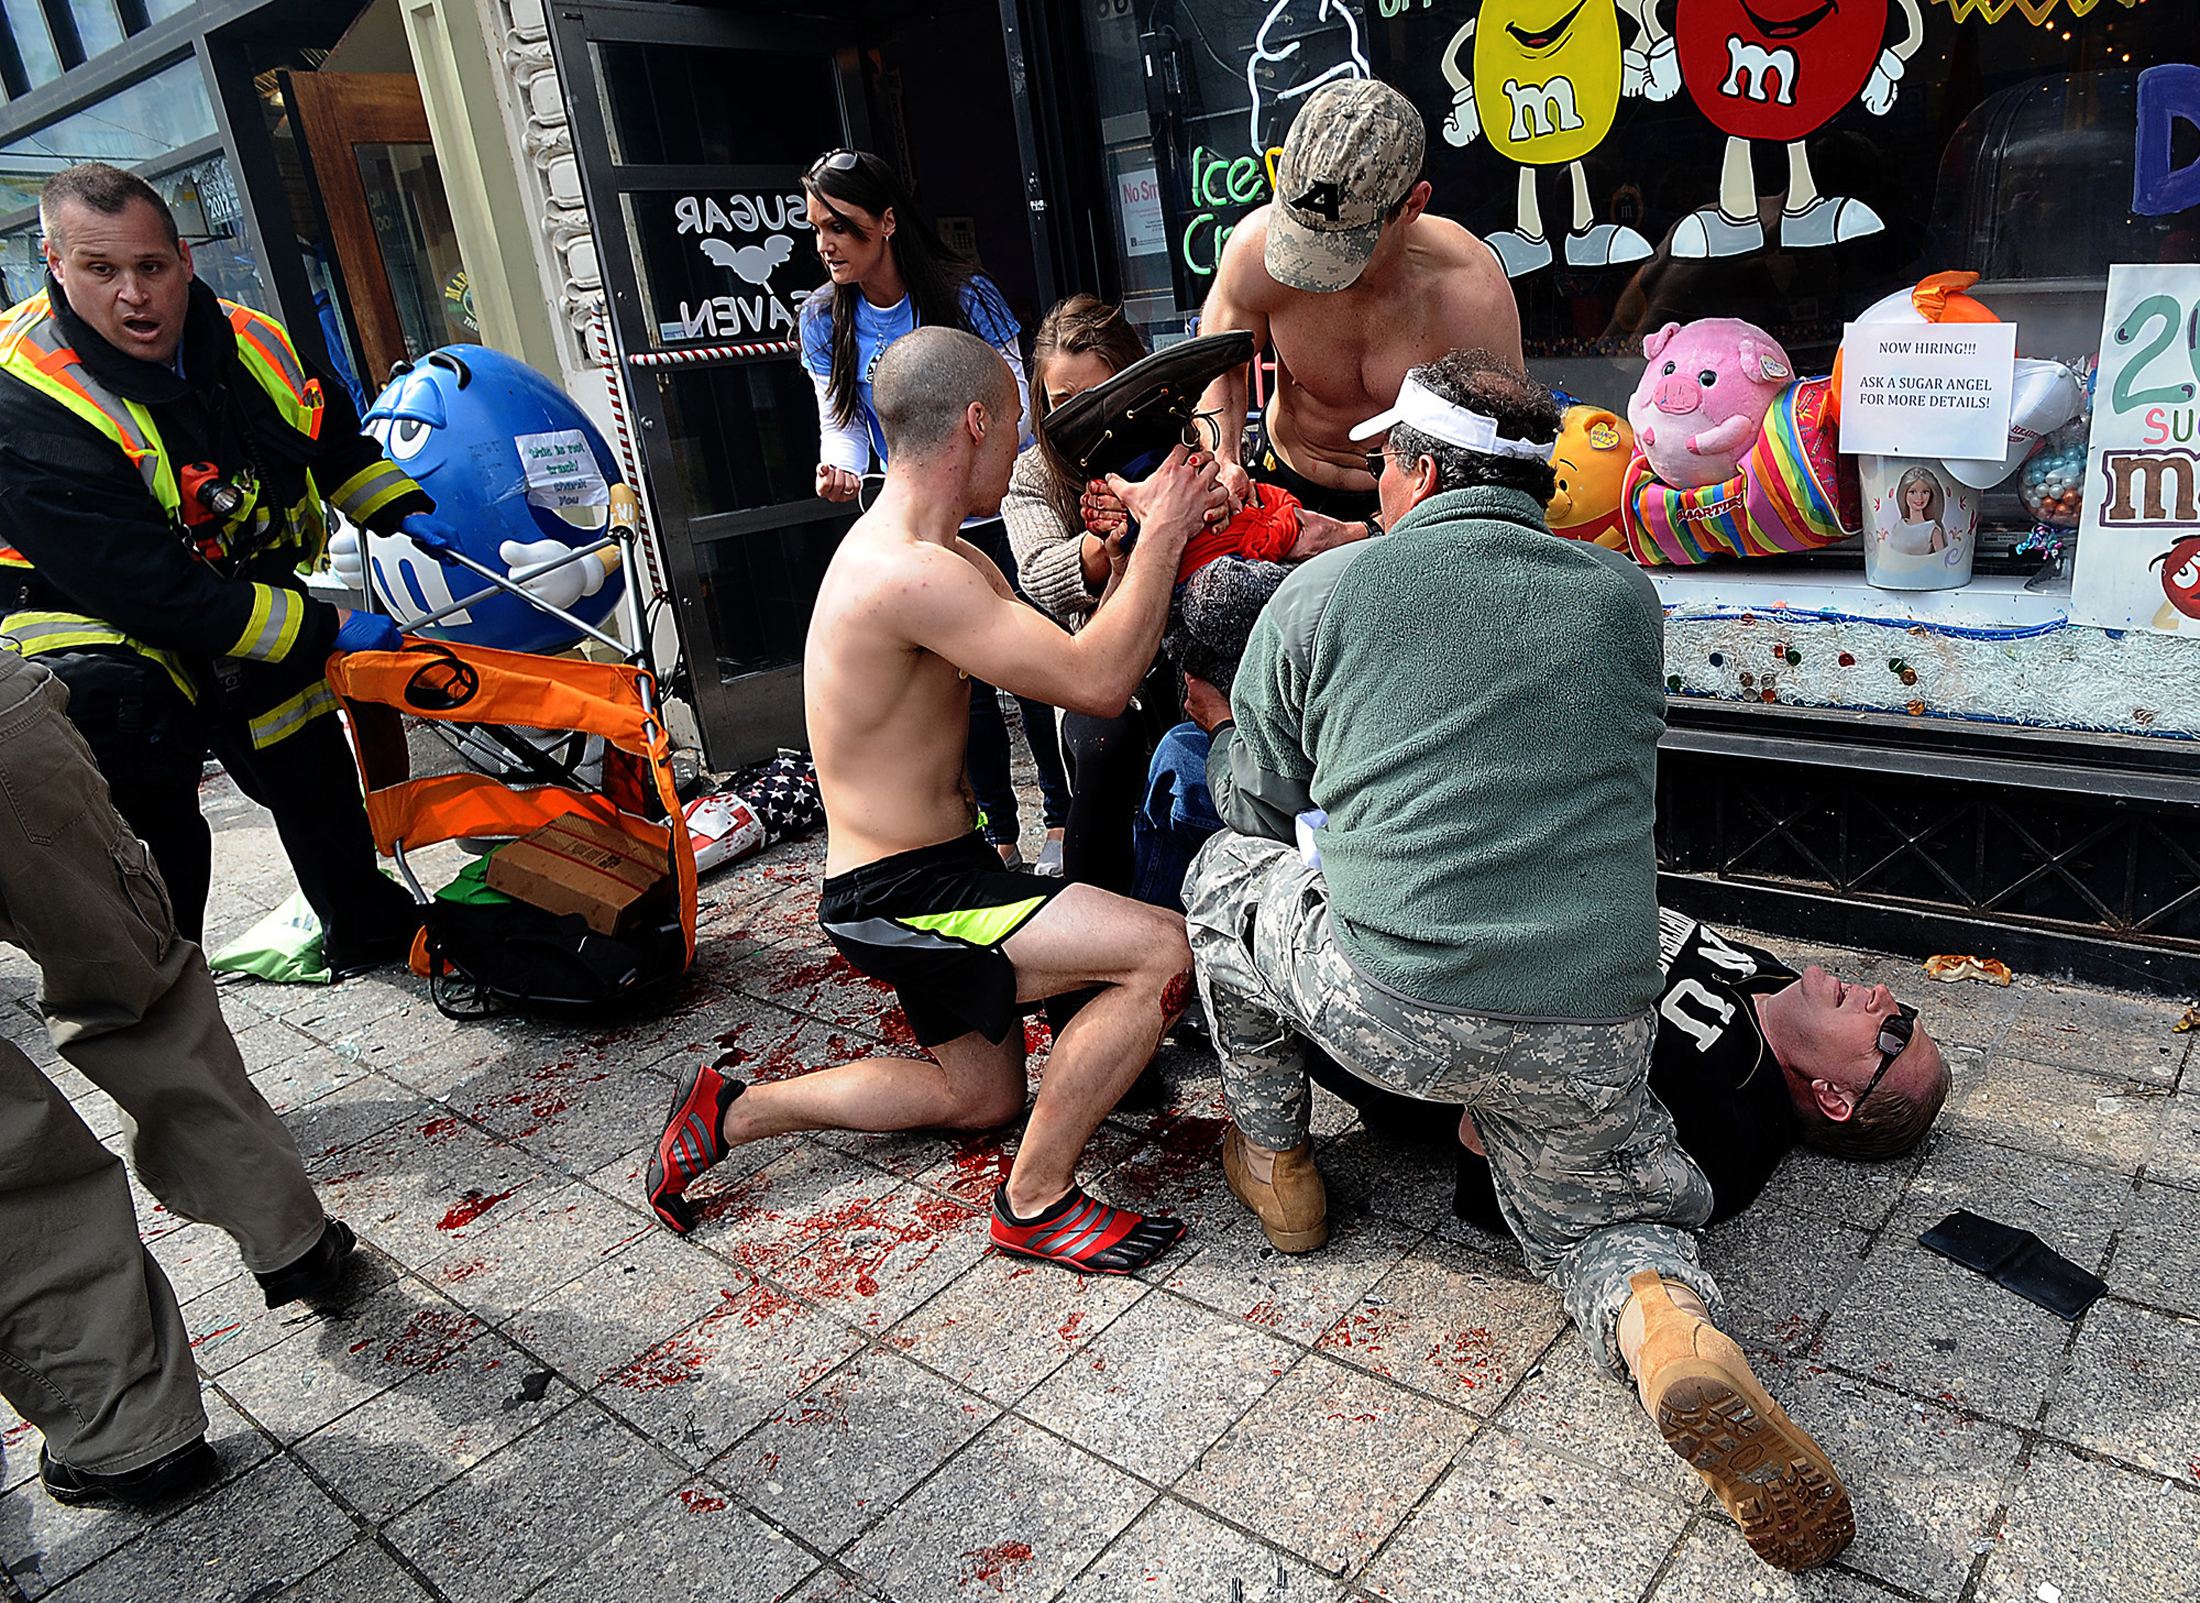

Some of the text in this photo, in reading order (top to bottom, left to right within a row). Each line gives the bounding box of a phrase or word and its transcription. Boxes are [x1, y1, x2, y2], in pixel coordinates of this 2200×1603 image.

[1502, 75, 1584, 142] m
[1122, 180, 1160, 204] No Sm
[1192, 146, 1264, 207] Ice
[206, 192, 232, 219] 2012
[1183, 213, 1234, 275] Cr
[1879, 341, 1977, 355] NOW HIRING!!!
[1859, 376, 1992, 391] ASK A SUGAR ANGEL
[1859, 393, 1990, 409] FOR MORE DETAILS!
[2143, 408, 2200, 445] SU
[2109, 457, 2200, 521] m
